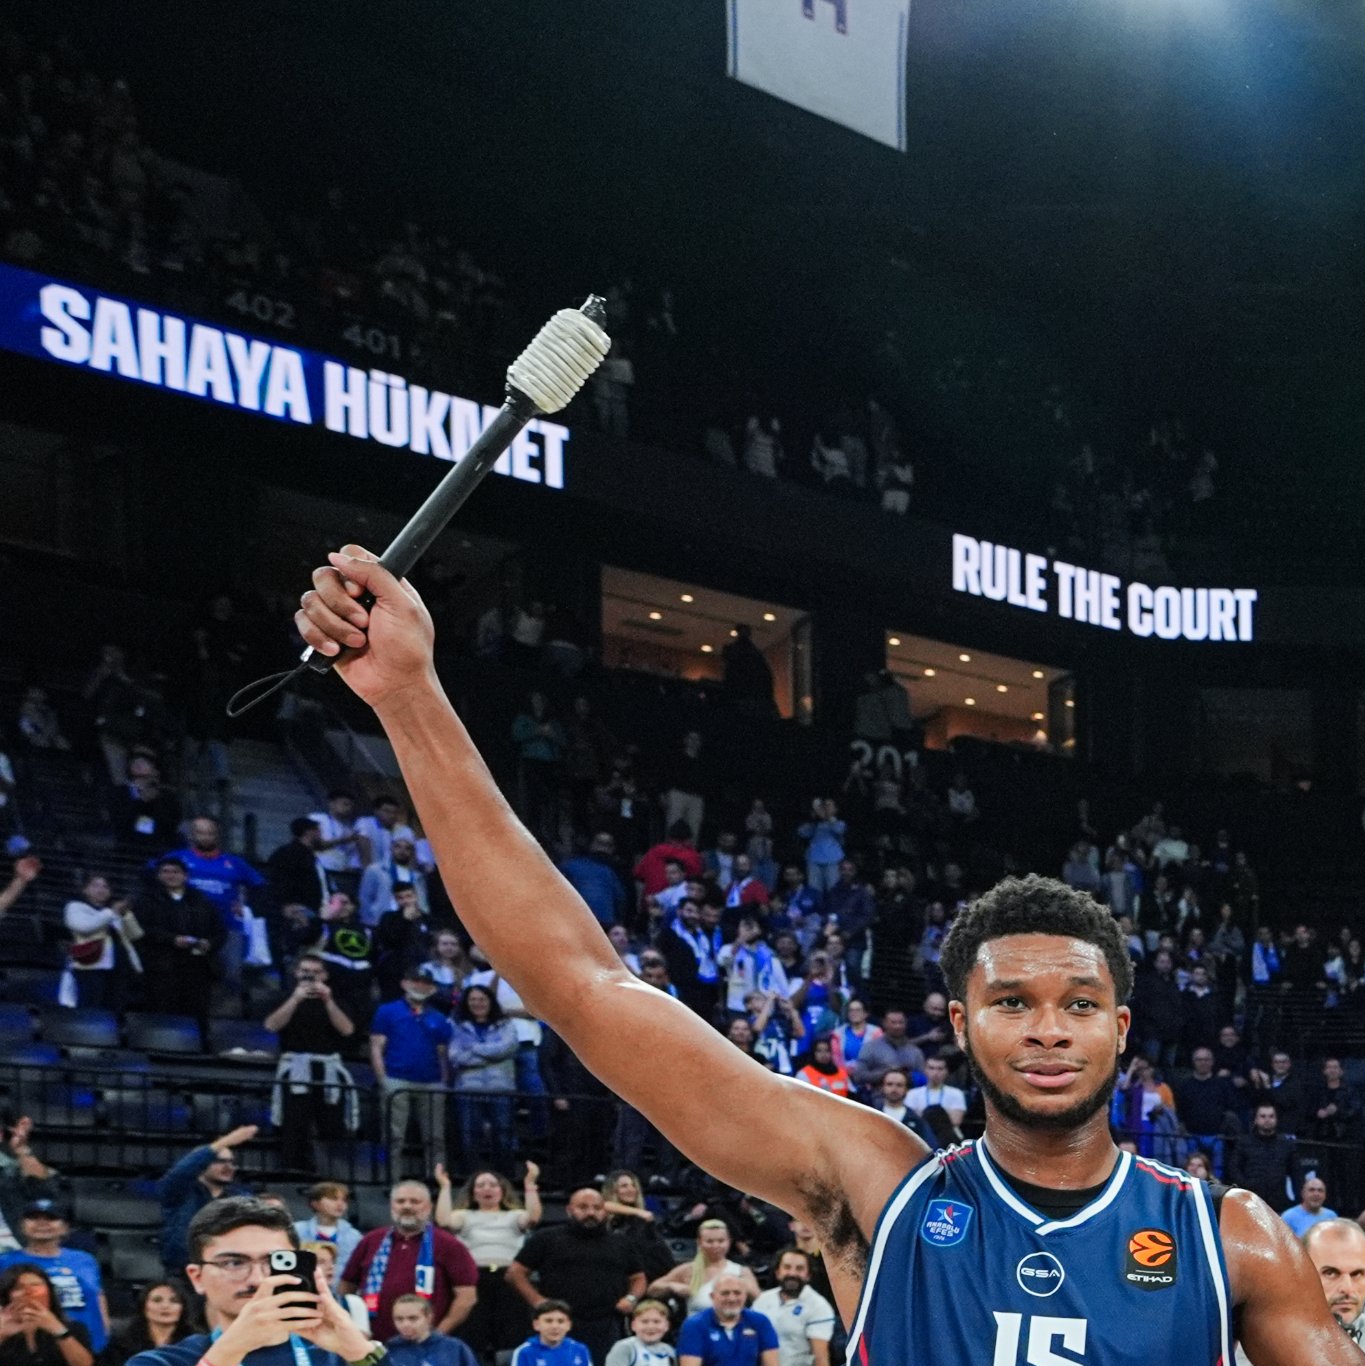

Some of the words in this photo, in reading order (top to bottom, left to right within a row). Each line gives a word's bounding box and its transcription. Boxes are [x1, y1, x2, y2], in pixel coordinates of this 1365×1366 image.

[39, 283, 312, 424] SAHAYA
[323, 360, 570, 490] HÜKMET
[952, 533, 1047, 612] RULE
[1053, 560, 1121, 630] THE
[1127, 583, 1258, 642] COURT
[926, 1221, 960, 1234] ANADOLU
[929, 1227, 954, 1237] EFES
[1020, 1267, 1060, 1278] GSA
[1126, 1273, 1174, 1284] ETIHAD
